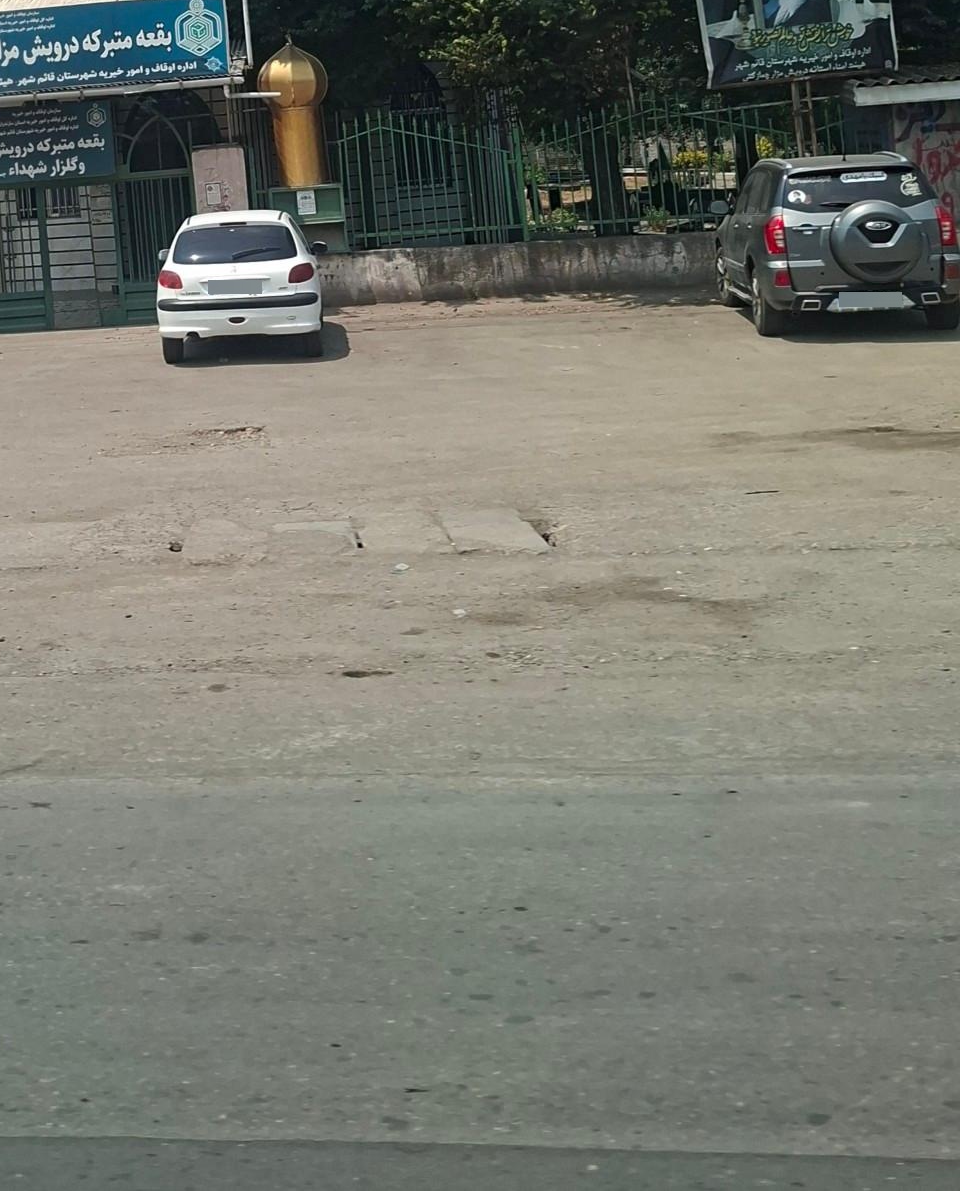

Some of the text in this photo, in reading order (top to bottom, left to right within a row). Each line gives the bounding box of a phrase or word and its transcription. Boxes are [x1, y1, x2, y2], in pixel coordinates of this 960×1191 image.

[83, 29, 133, 58] متبرکه
[136, 23, 172, 52] بقعه
[24, 35, 78, 65] درویش
[99, 67, 124, 79] خیریه
[125, 66, 143, 77] امور
[145, 67, 150, 75] و
[153, 63, 176, 74] اوقاف
[177, 61, 197, 73] اداره
[17, 75, 36, 87] شهر
[37, 72, 55, 84] قائم
[57, 69, 97, 82] شهرستان
[37, 138, 75, 155] متبرکه
[78, 133, 105, 151] بقعه
[8, 161, 47, 178] شهداء
